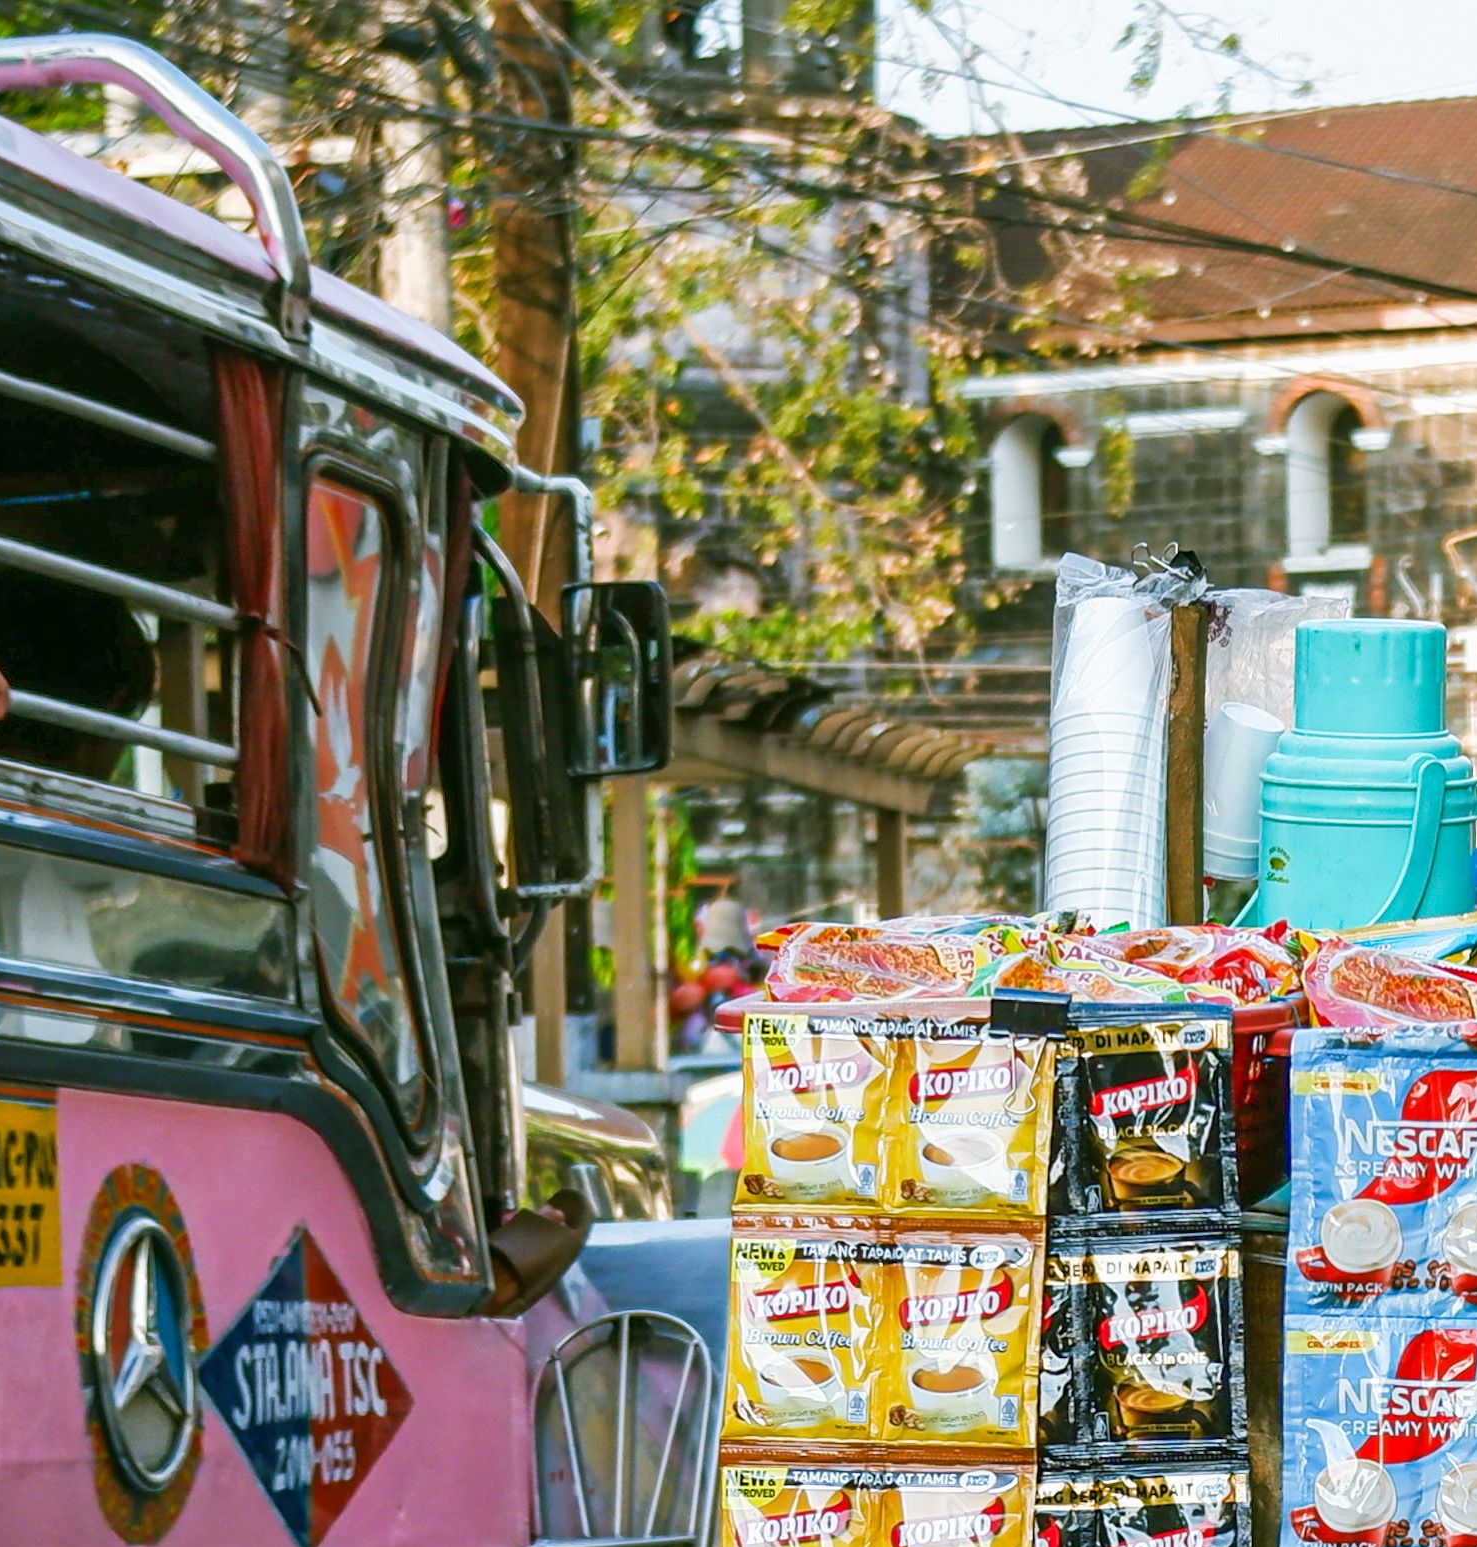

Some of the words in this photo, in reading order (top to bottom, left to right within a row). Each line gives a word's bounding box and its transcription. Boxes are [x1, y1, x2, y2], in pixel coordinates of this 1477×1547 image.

[766, 1061, 858, 1094] KOPIKO
[917, 1066, 1011, 1098] KOPIKO
[1103, 1075, 1188, 1113] KOPIKO
[1344, 1161, 1427, 1179] CREAMY
[755, 1286, 847, 1318] KOPIKO
[906, 1291, 1002, 1323] KOPIKO
[1109, 1305, 1198, 1343] KOPIKO
[1339, 1420, 1420, 1438] CREAMY
[746, 1511, 839, 1547] KOPIKO
